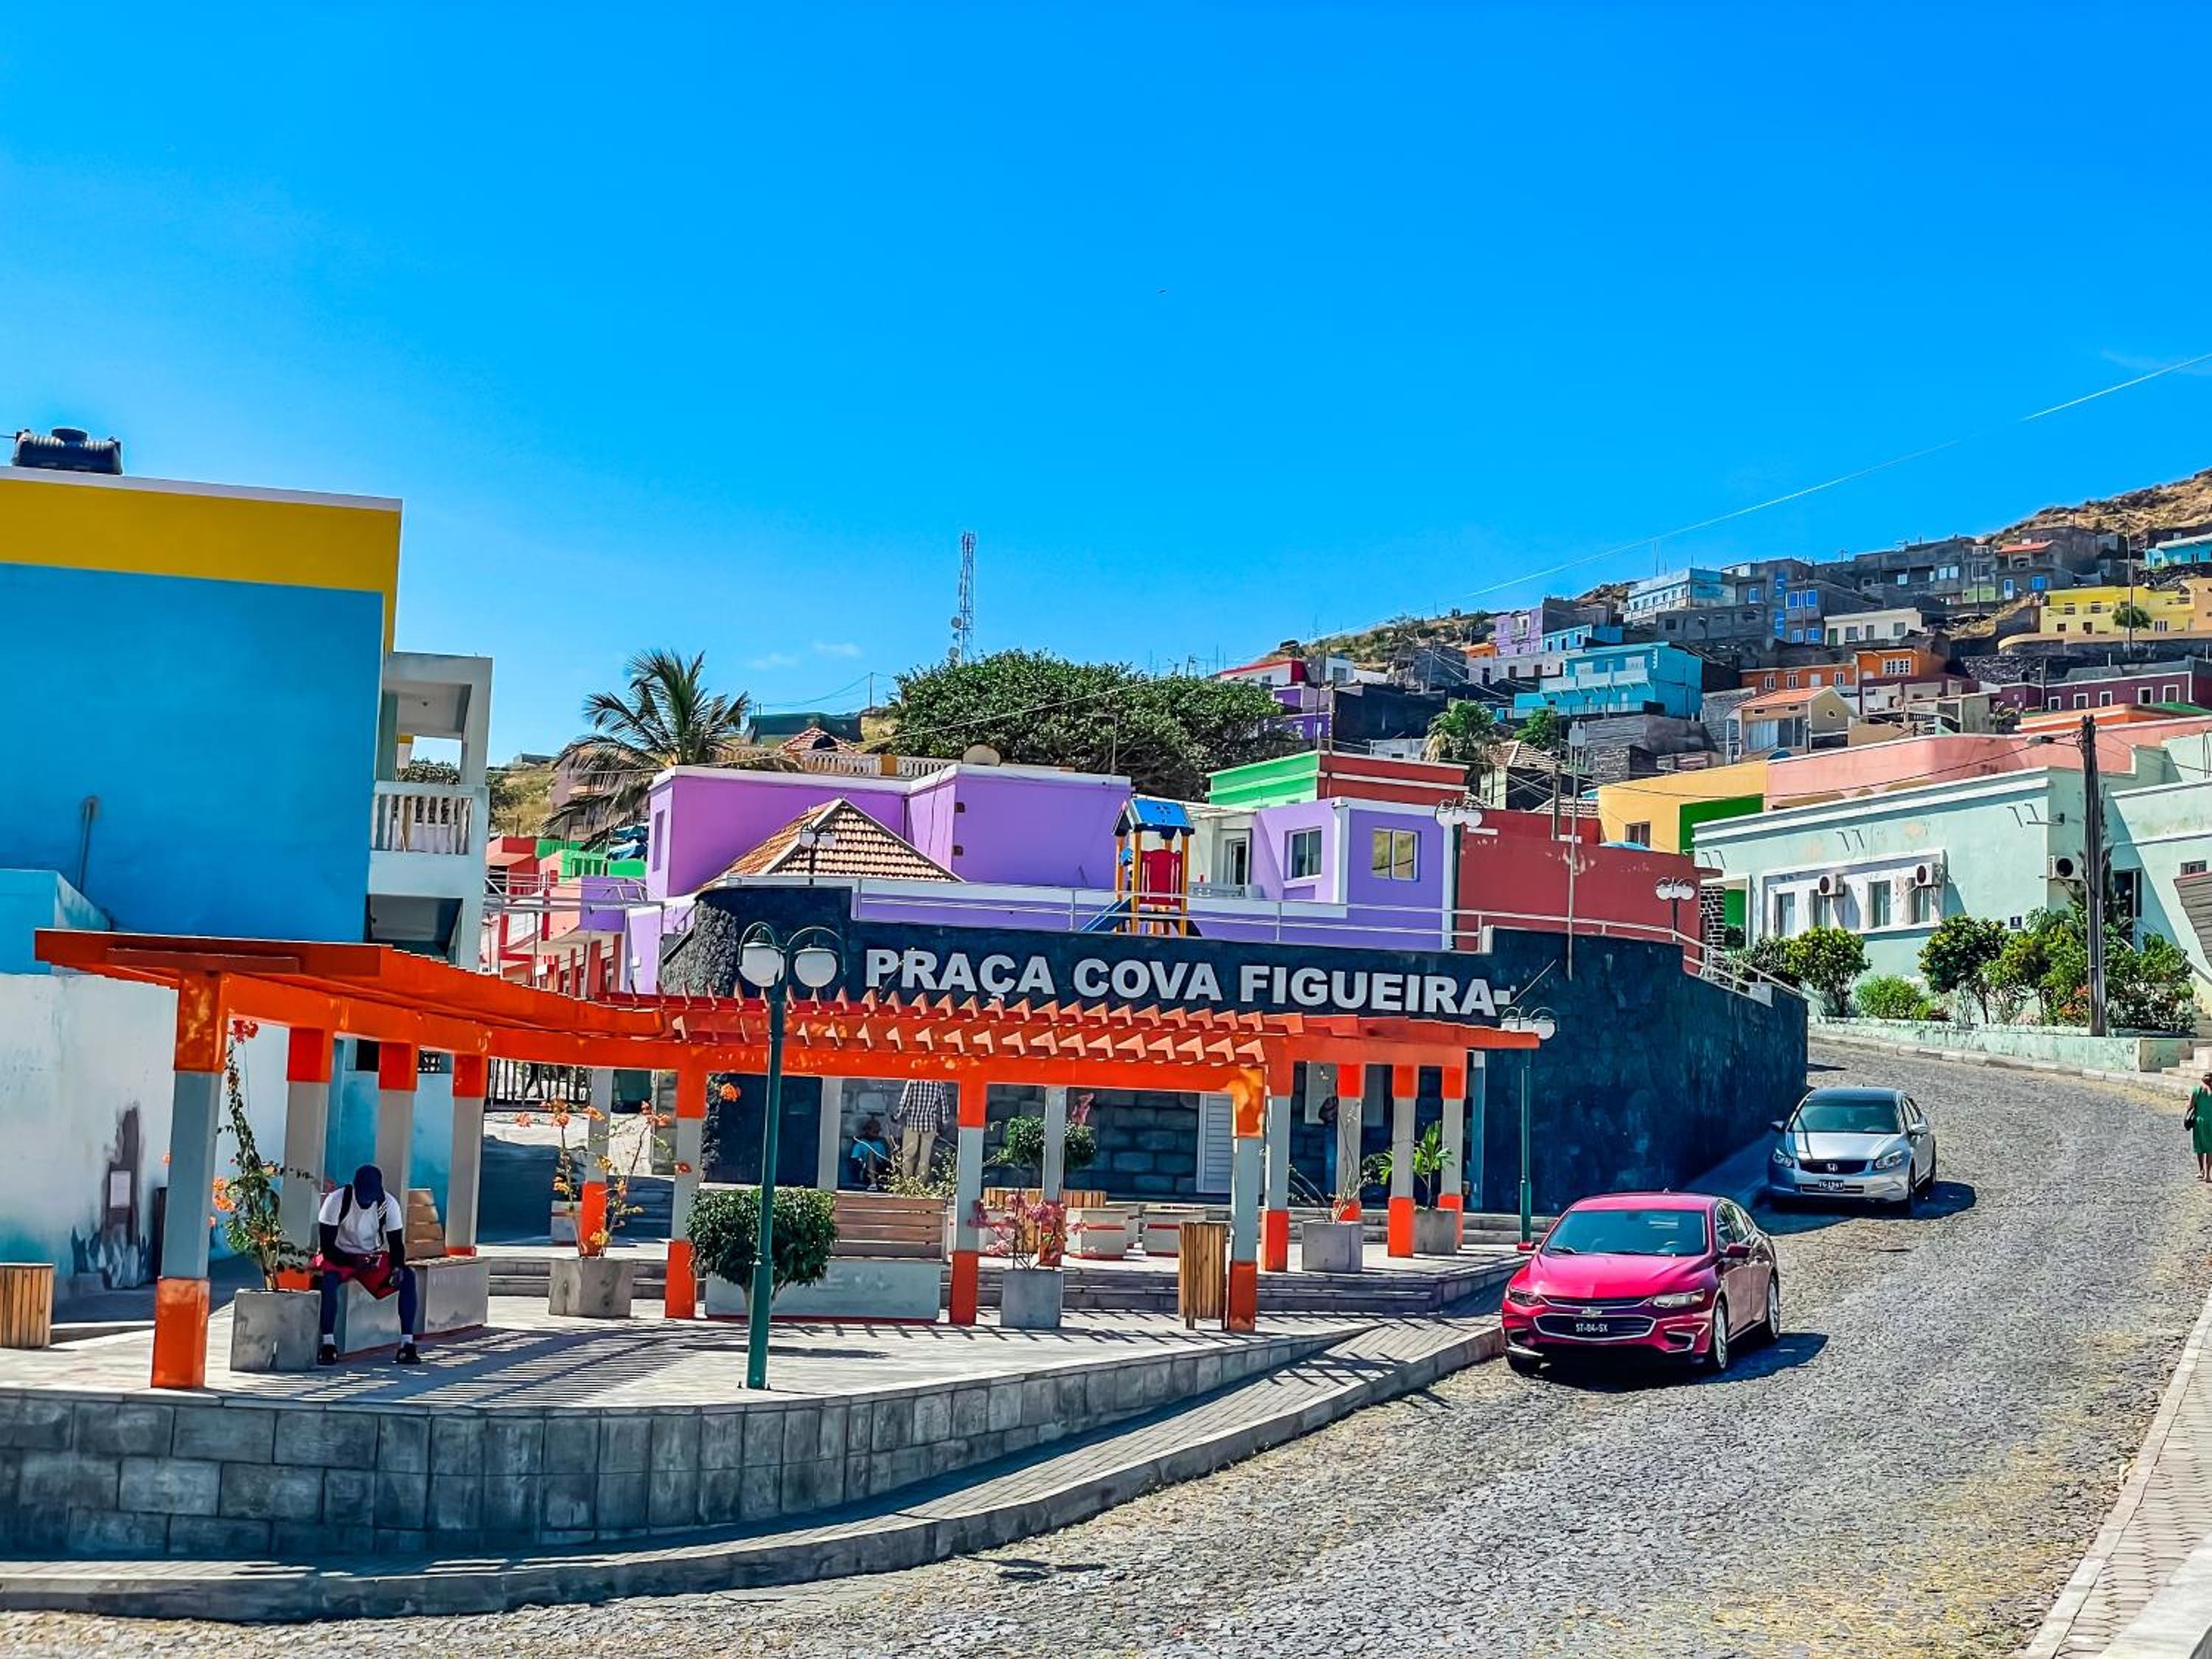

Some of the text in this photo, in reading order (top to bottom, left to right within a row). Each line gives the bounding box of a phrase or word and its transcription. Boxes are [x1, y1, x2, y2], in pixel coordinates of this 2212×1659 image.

[866, 949, 1496, 1017] PRAÇA COVA FIGUEIRA
